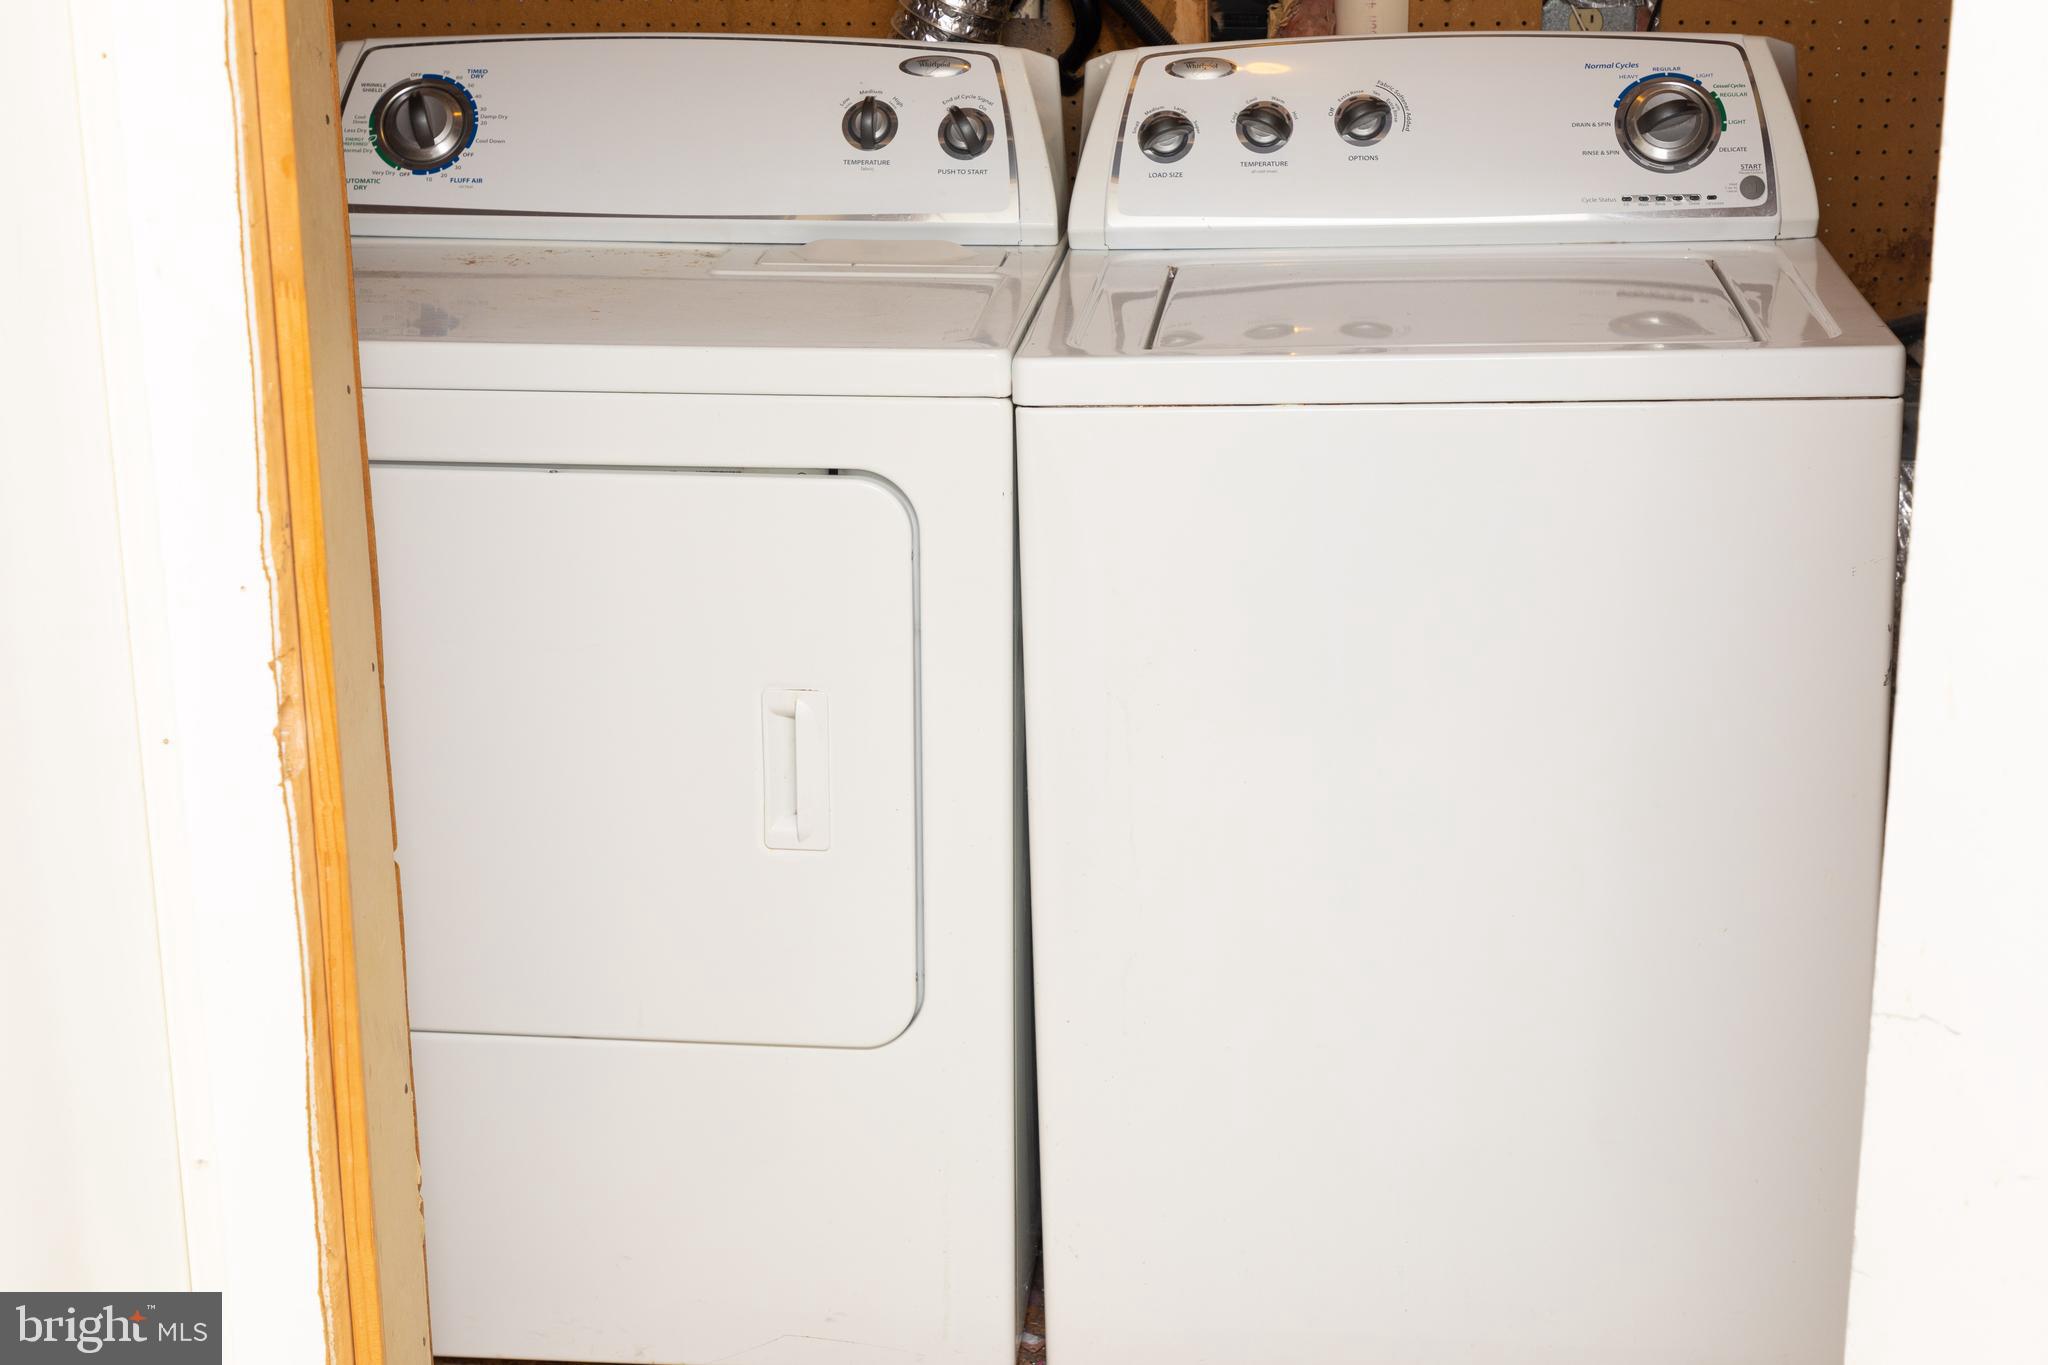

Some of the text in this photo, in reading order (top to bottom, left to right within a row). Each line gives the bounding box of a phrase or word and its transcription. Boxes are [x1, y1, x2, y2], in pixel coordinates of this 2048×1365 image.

[1185, 62, 1219, 70] Whirlpool
[1584, 62, 1639, 70] Normal Cycles
[1377, 80, 1393, 92] Fabric
[1394, 89, 1410, 112] Softener
[892, 96, 904, 108] High
[978, 96, 995, 106] Signal
[979, 104, 987, 112] On
